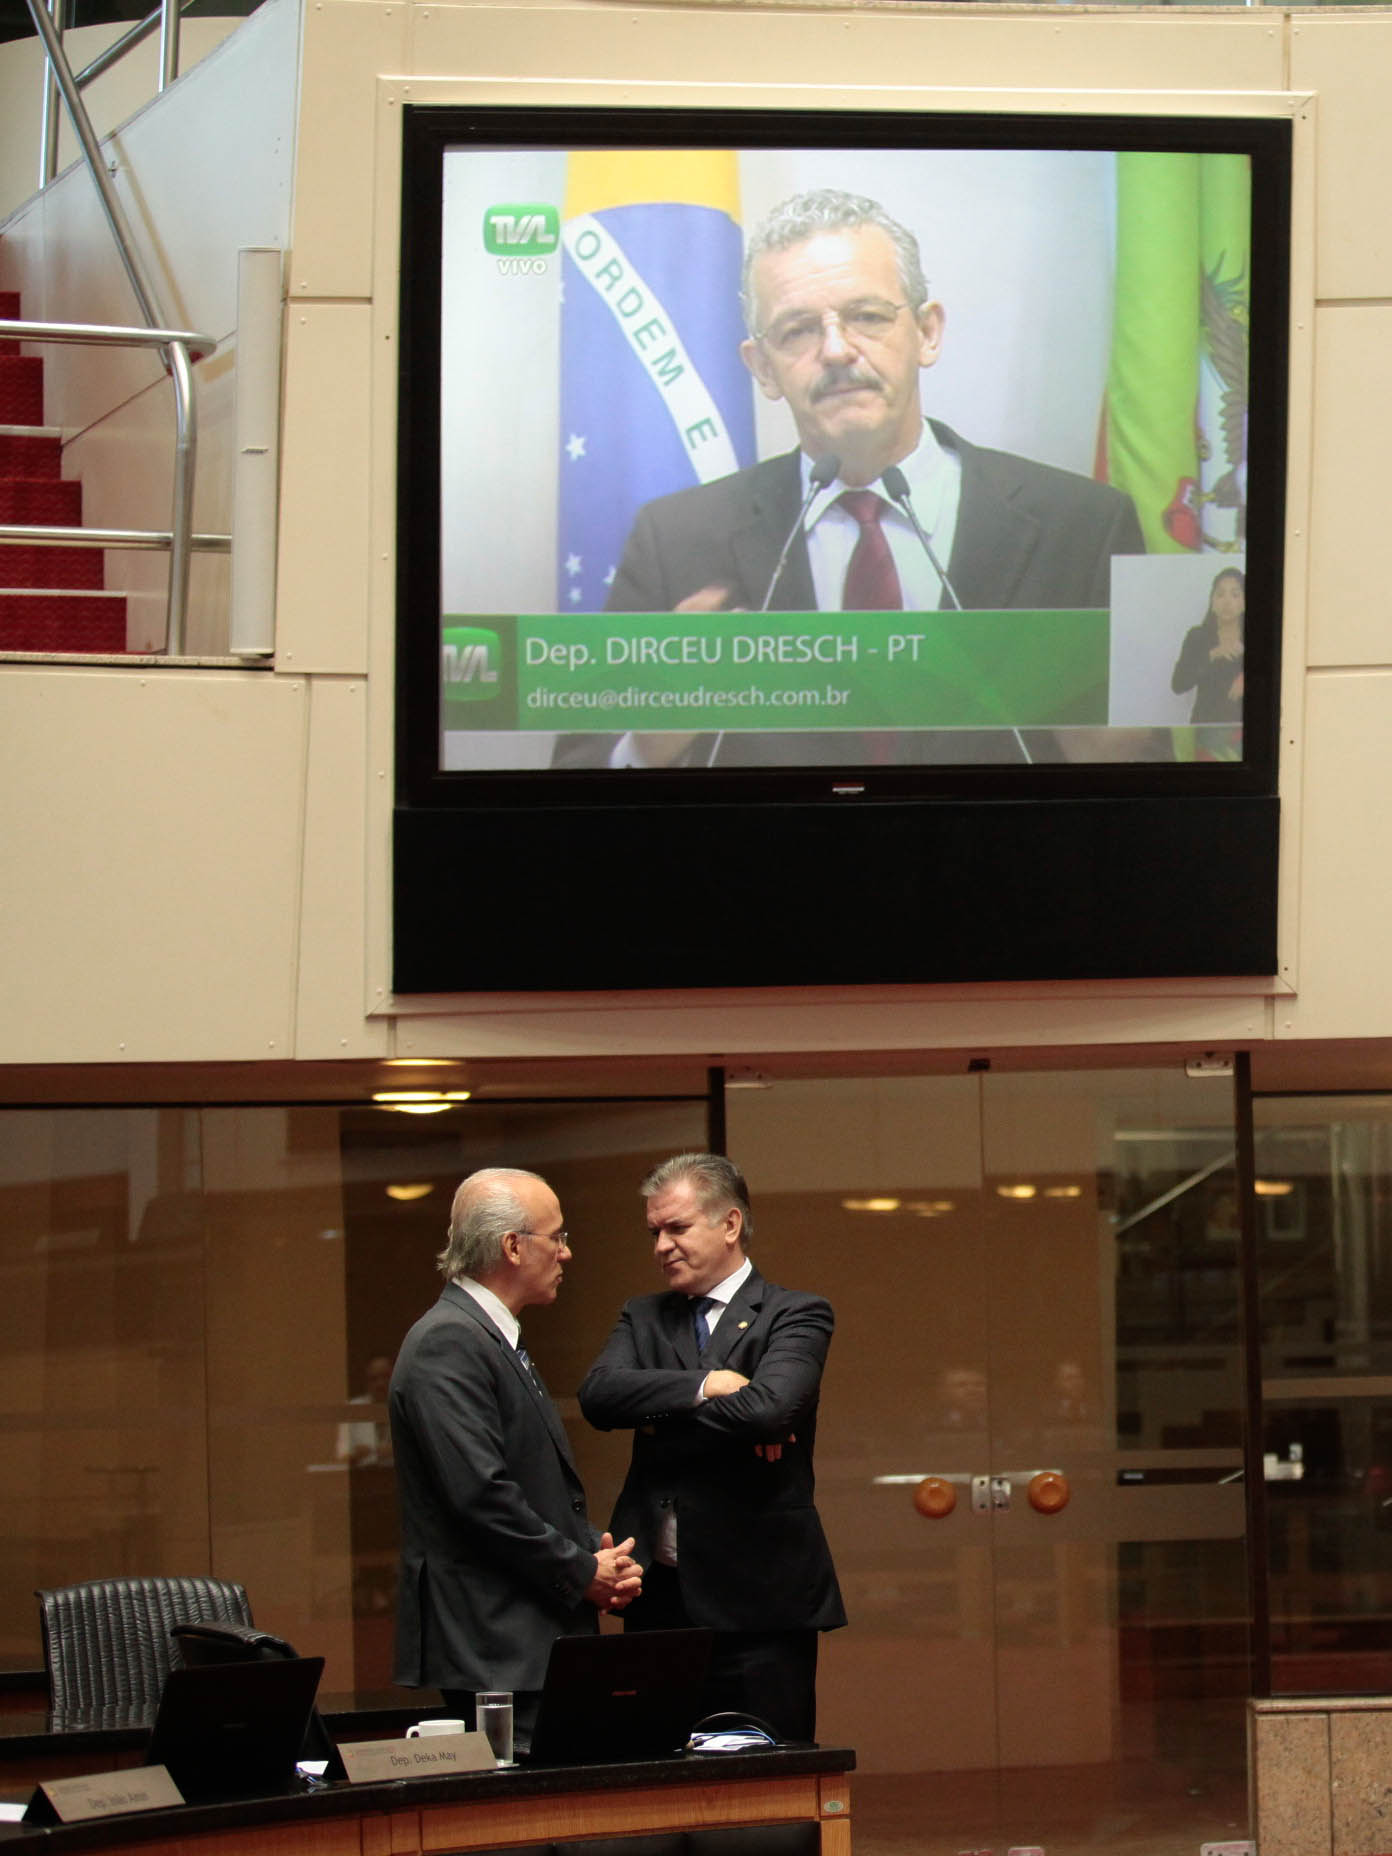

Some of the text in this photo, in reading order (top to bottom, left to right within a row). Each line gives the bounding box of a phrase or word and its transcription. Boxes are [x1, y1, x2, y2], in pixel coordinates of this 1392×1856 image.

[497, 259, 547, 274] VIVO
[575, 230, 718, 449] ORDEM E
[525, 636, 597, 671] Dep.
[605, 636, 722, 665] DIRCEU
[732, 634, 859, 663] DRESCH
[887, 634, 926, 661] PT
[526, 684, 851, 709] dirceu@dirceudresch.com.br
